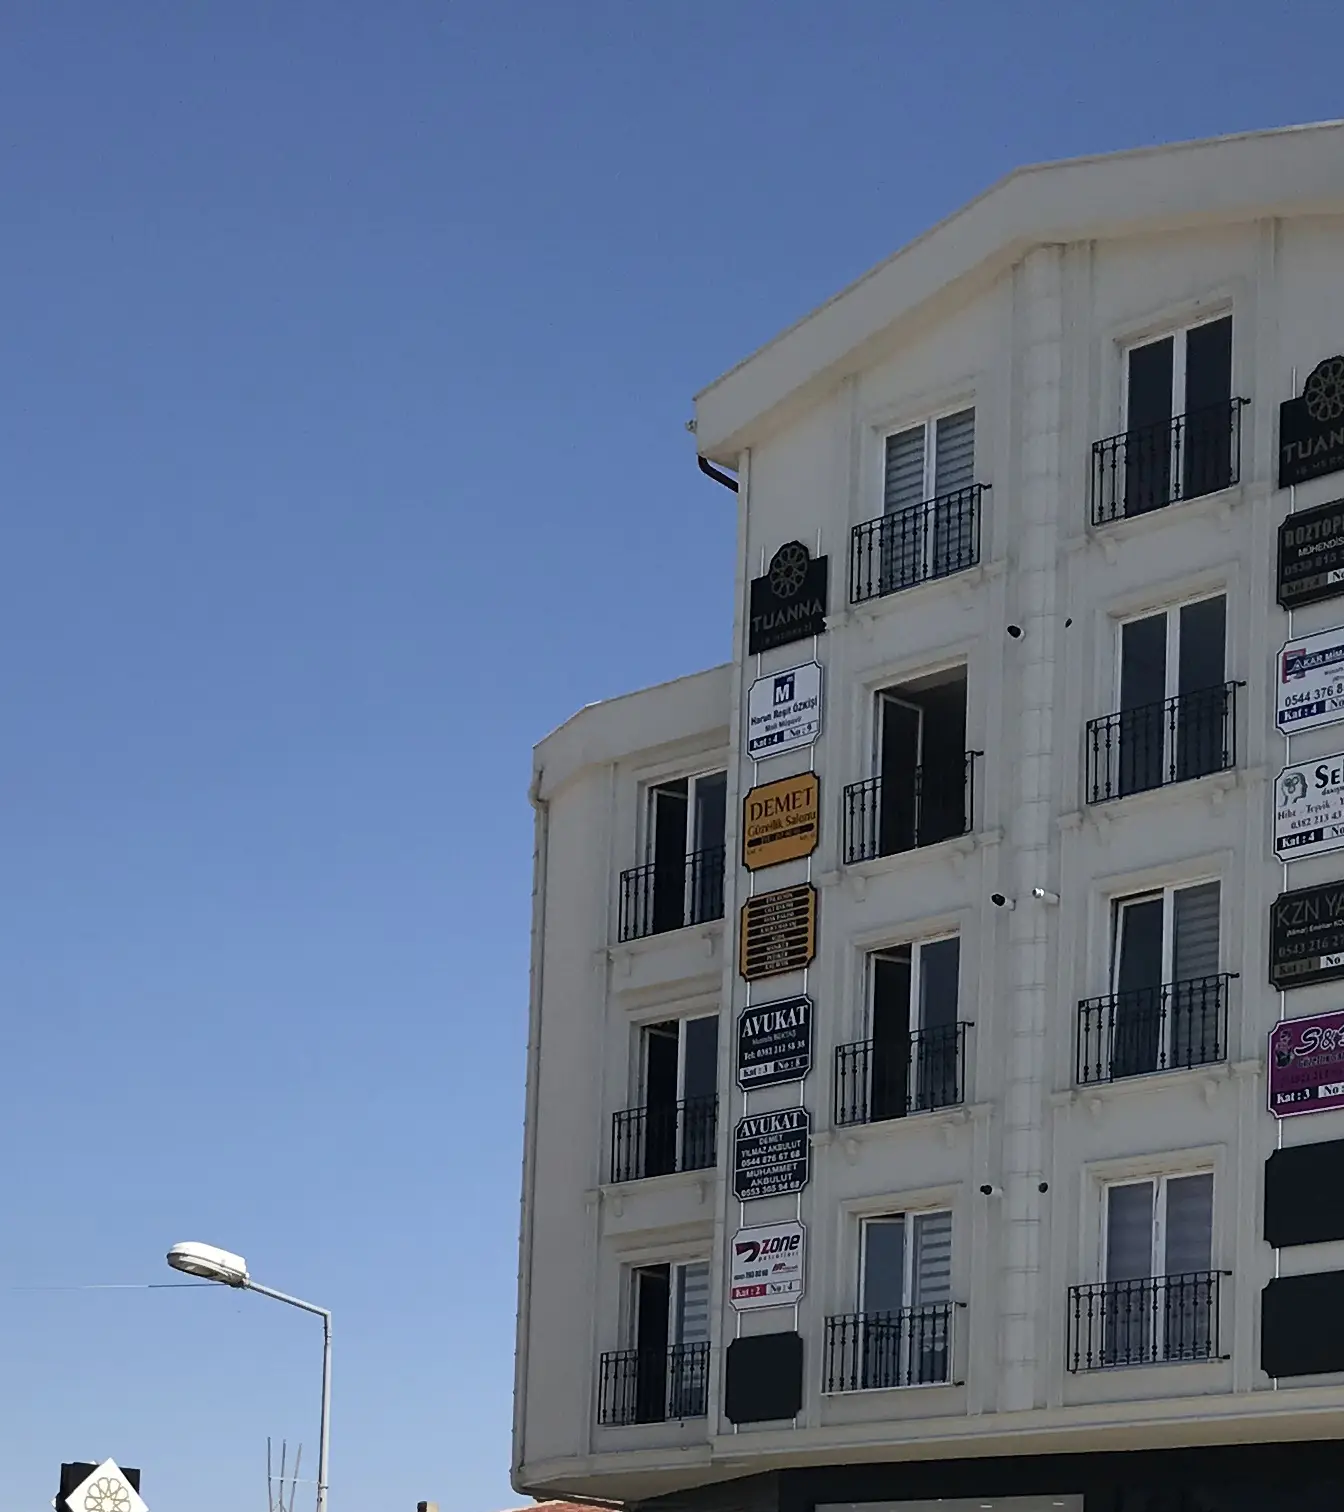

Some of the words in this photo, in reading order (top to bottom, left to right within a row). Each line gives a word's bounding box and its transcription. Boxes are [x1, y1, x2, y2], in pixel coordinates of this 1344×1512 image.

[752, 598, 823, 632] TUANNA
[1285, 691, 1311, 707] 0544
[1314, 685, 1334, 700] 376
[1284, 708, 1302, 721] Kat
[1311, 704, 1317, 714] 4
[750, 786, 814, 822] DEMET
[1282, 836, 1300, 848] Kat
[1276, 897, 1319, 927] KZN
[1326, 956, 1340, 966] No
[742, 1004, 808, 1038] AVUKAT
[1277, 1092, 1295, 1104] Kat
[1304, 1088, 1310, 1100] 3
[1324, 1085, 1338, 1095] No
[740, 1112, 801, 1137] AVUKAT
